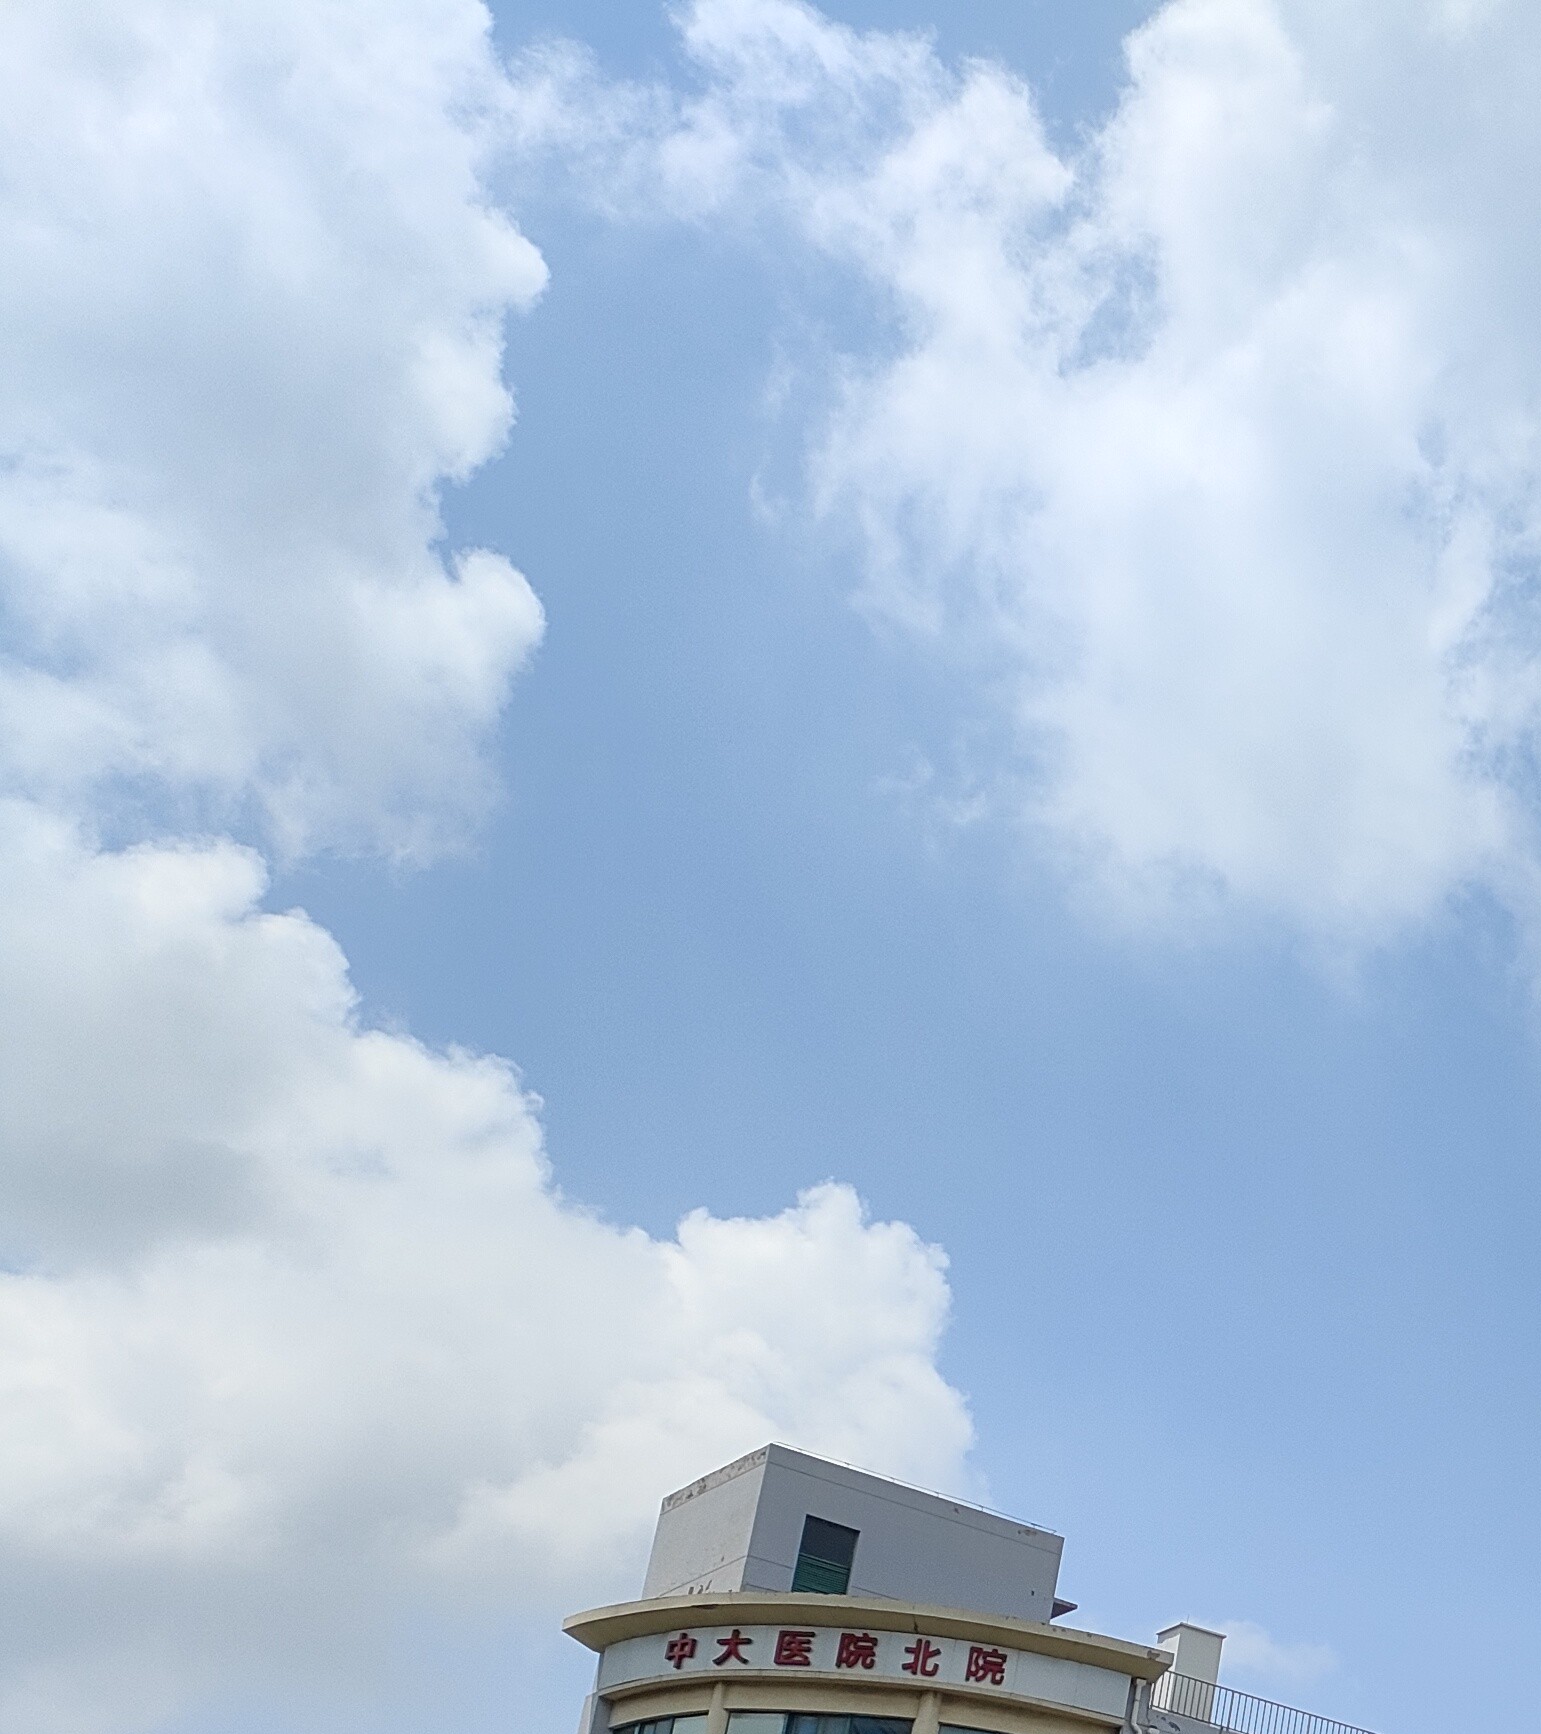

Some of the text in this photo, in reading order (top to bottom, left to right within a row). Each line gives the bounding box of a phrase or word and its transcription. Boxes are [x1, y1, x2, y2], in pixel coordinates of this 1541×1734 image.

[664, 1628, 1008, 1686] 中大医院北院
